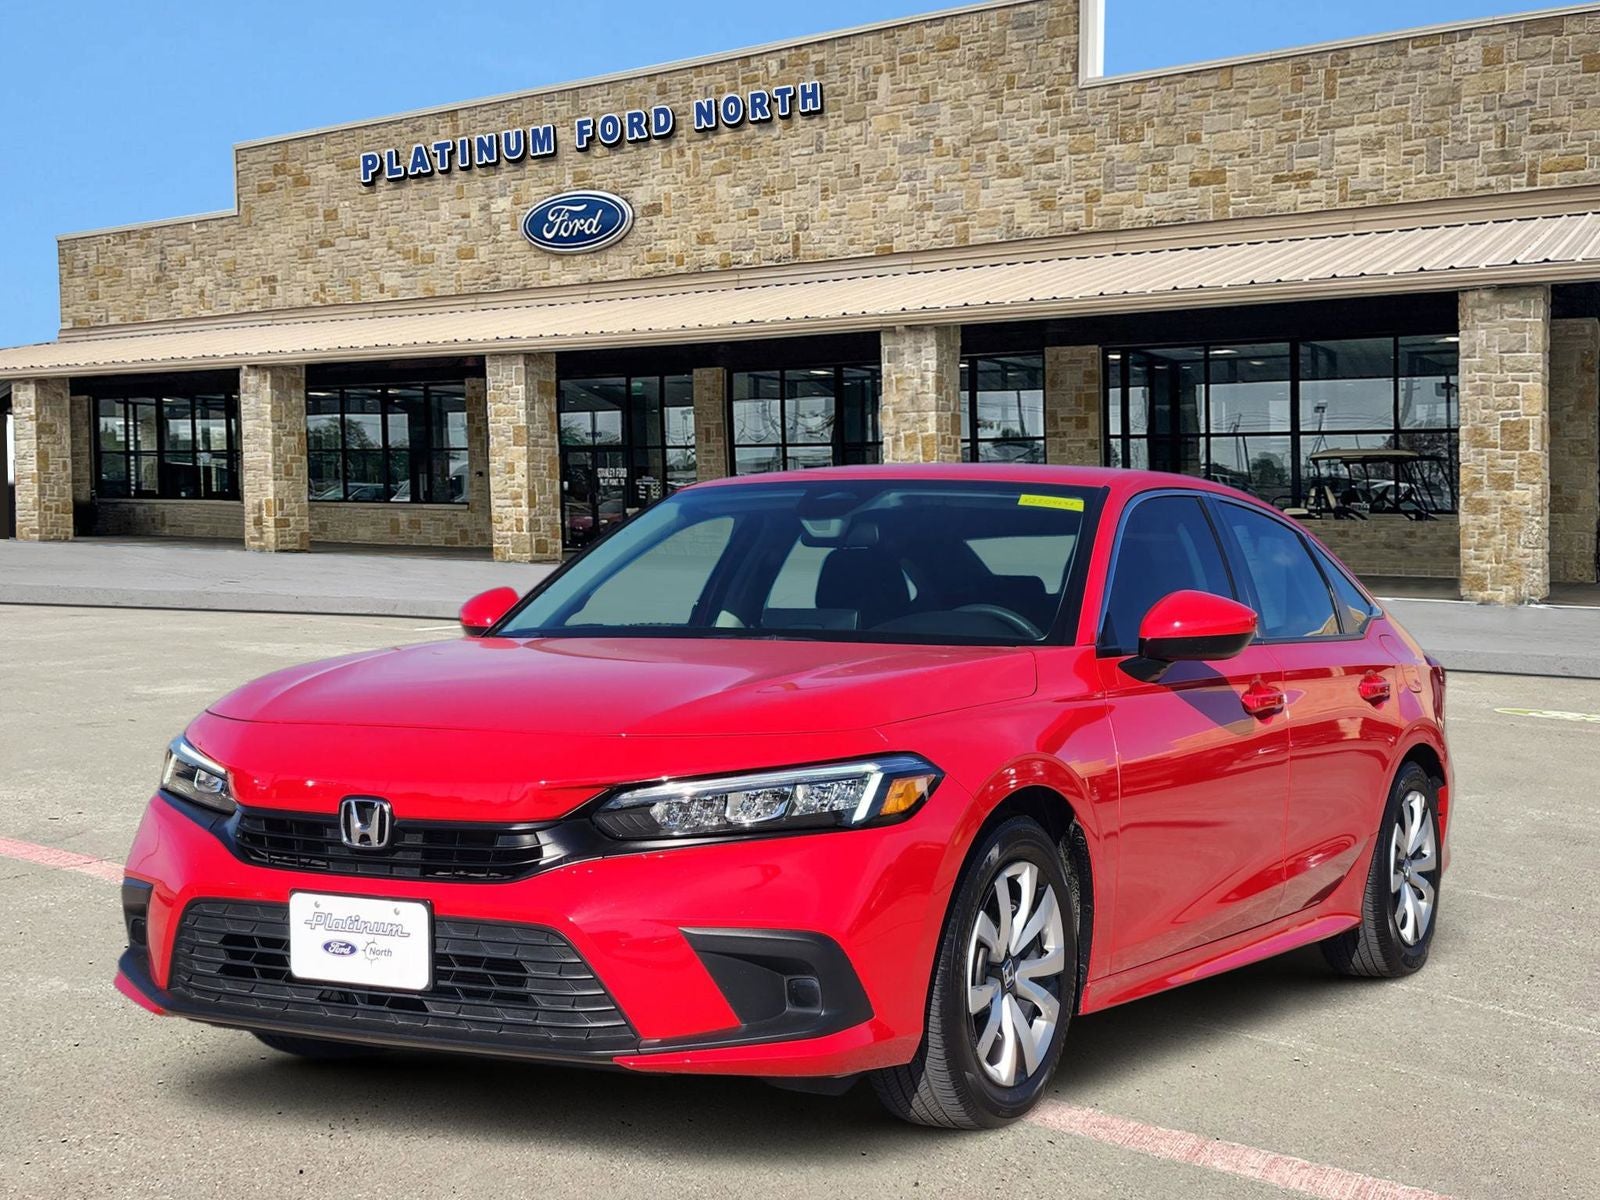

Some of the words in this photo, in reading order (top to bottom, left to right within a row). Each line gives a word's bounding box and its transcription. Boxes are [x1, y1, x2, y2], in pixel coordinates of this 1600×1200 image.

[361, 124, 556, 183] PLATINUM
[576, 105, 674, 149] FORD
[695, 81, 822, 132] NORTH
[541, 203, 603, 239] Ford
[304, 911, 411, 938] Platinum
[328, 943, 352, 955] Ford
[369, 947, 392, 957] North
